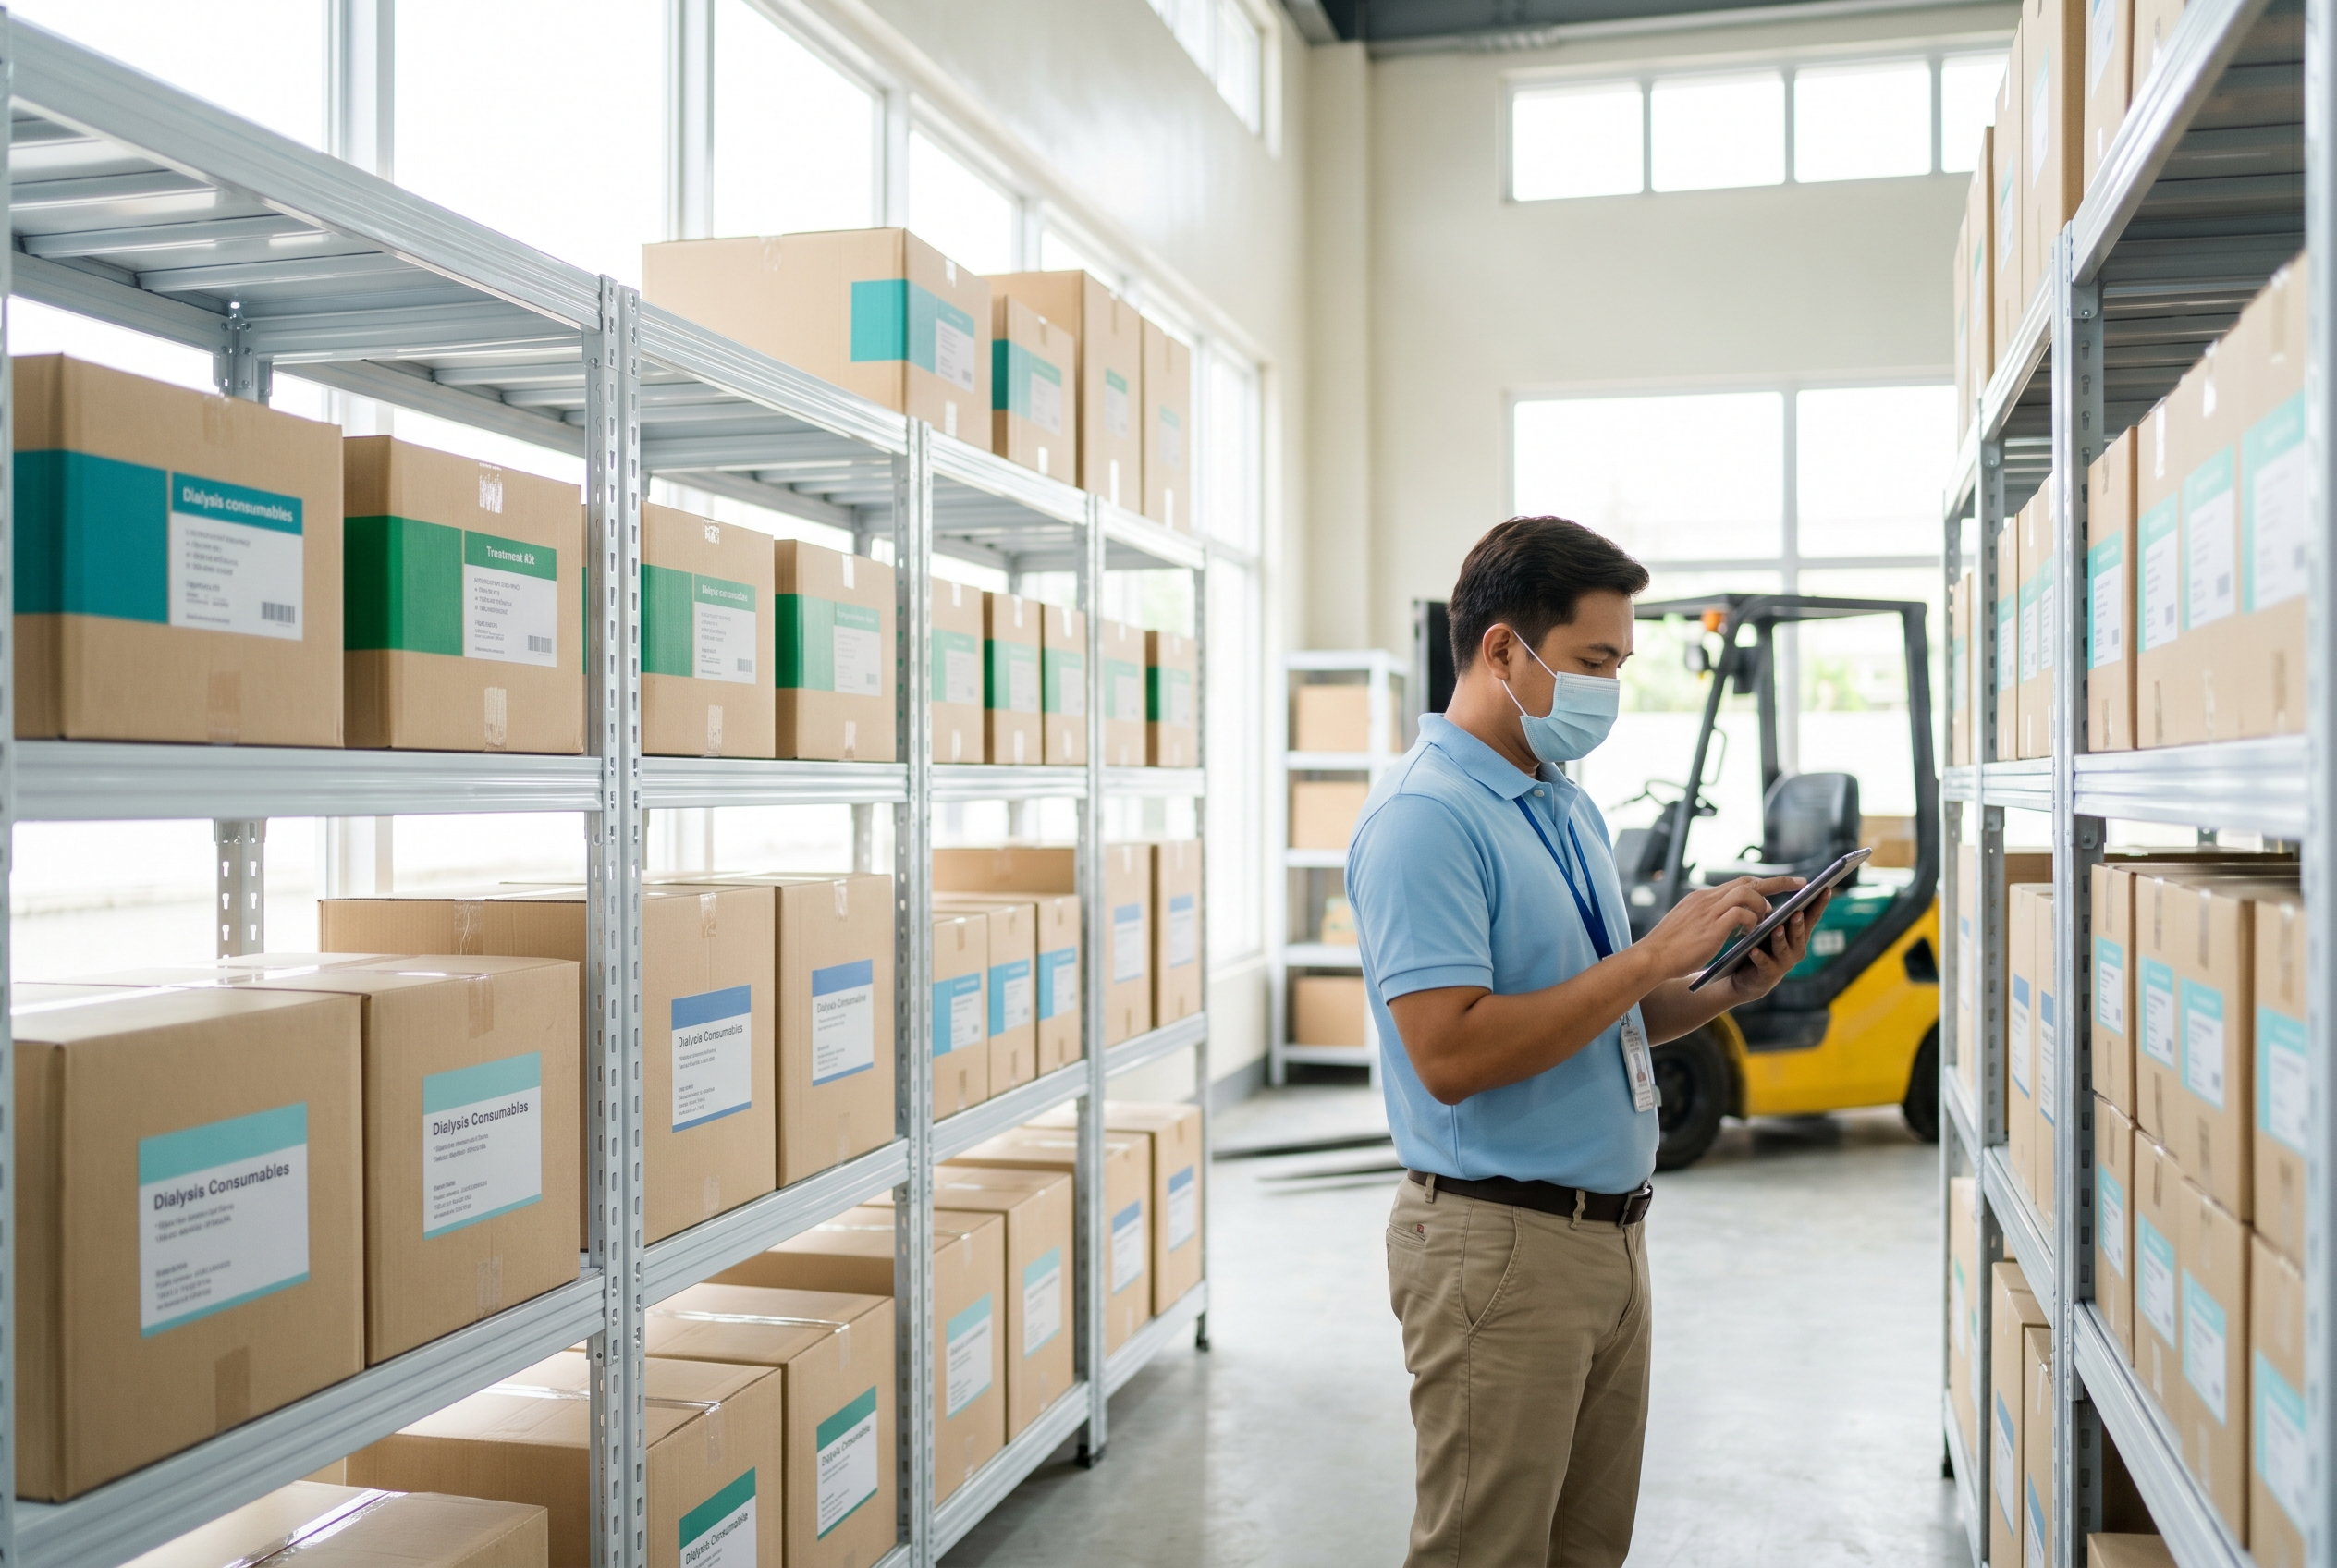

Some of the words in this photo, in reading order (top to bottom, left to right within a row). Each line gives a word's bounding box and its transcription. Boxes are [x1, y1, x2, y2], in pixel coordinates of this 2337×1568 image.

[182, 486, 225, 509] Dialysis
[225, 497, 294, 523] consumables
[433, 1116, 470, 1136] Dialysis
[471, 1101, 529, 1126] Consumables
[153, 1183, 205, 1211] Dialysis
[208, 1163, 290, 1196] Consumables
